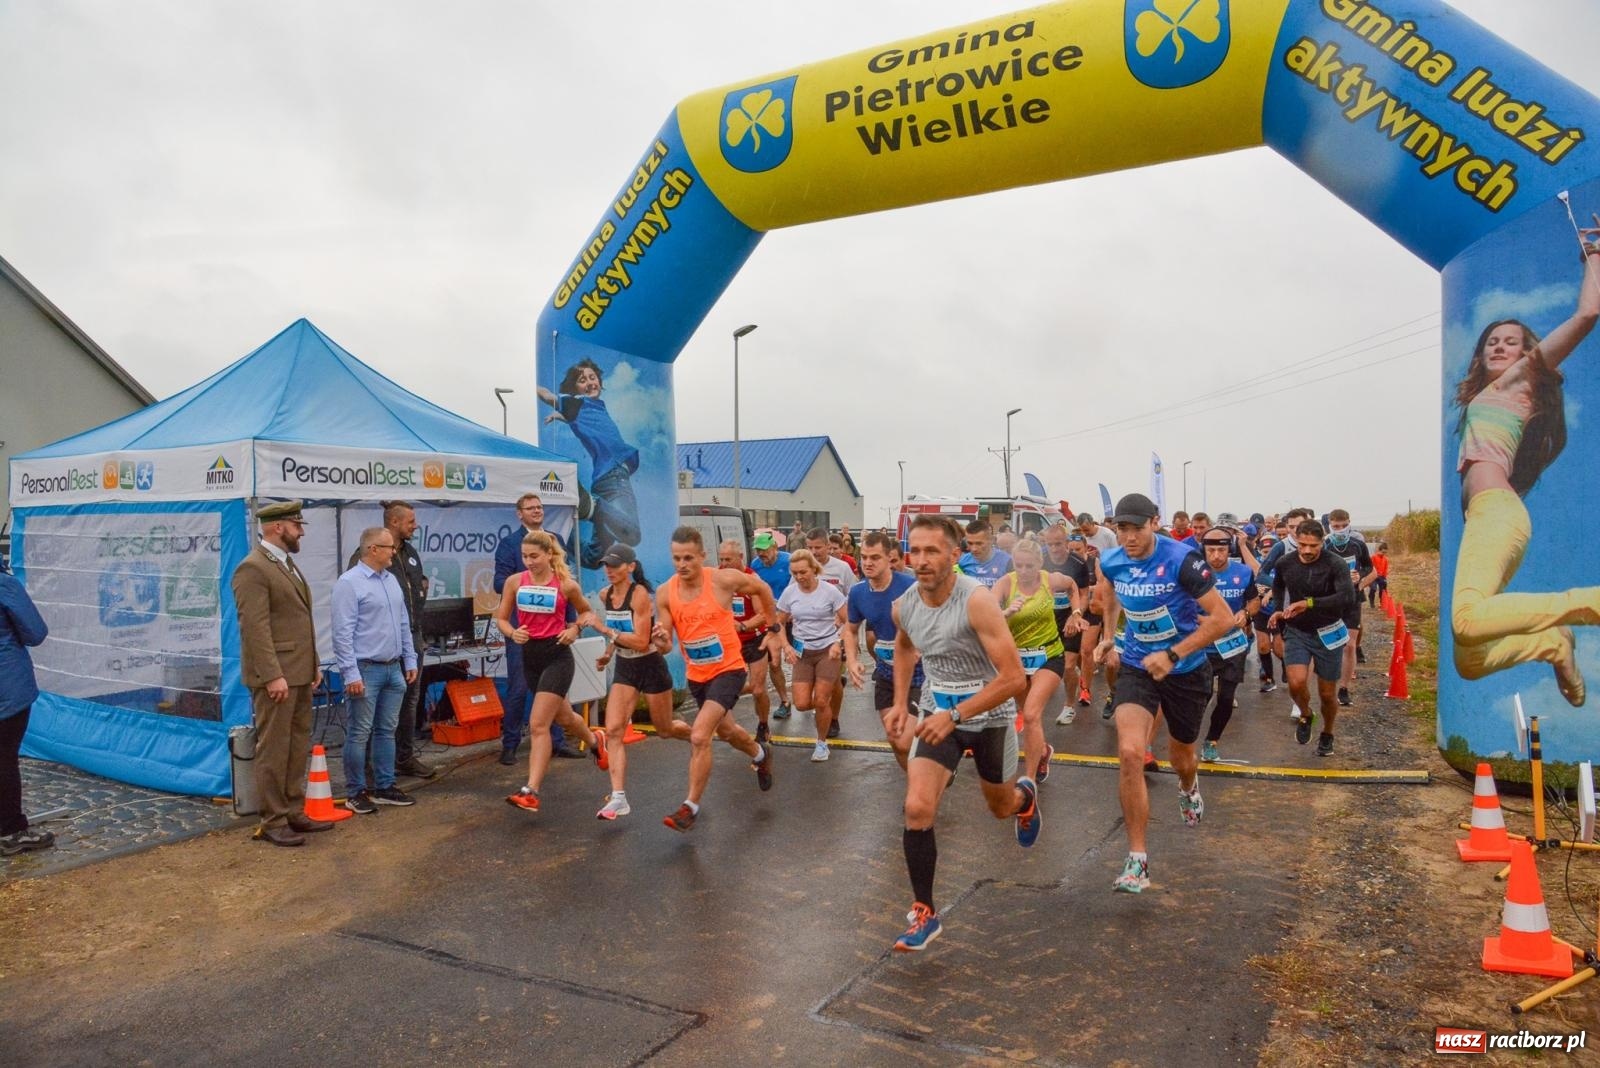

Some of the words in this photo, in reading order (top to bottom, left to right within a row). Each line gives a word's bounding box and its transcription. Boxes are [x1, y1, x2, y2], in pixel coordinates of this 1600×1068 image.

[868, 20, 1036, 74] Gmina
[825, 44, 1084, 123] Pietrowice
[1320, 0, 1457, 85] Gmina
[1451, 69, 1585, 165] ludzi
[857, 93, 1051, 157] Wielkie
[1284, 38, 1518, 213] aktywnych
[552, 220, 615, 311] Gmina
[615, 140, 669, 220] ludzi
[575, 167, 693, 332] aktywnych
[21, 468, 99, 494] PersonalBest
[206, 470, 234, 484] MITKO
[282, 457, 417, 486] PersonalBest
[540, 481, 564, 493] MITKO
[528, 594, 545, 607] 12
[1138, 621, 1159, 634] 64
[1335, 630, 1342, 640] 3
[694, 646, 712, 659] 25
[1226, 637, 1241, 649] 13
